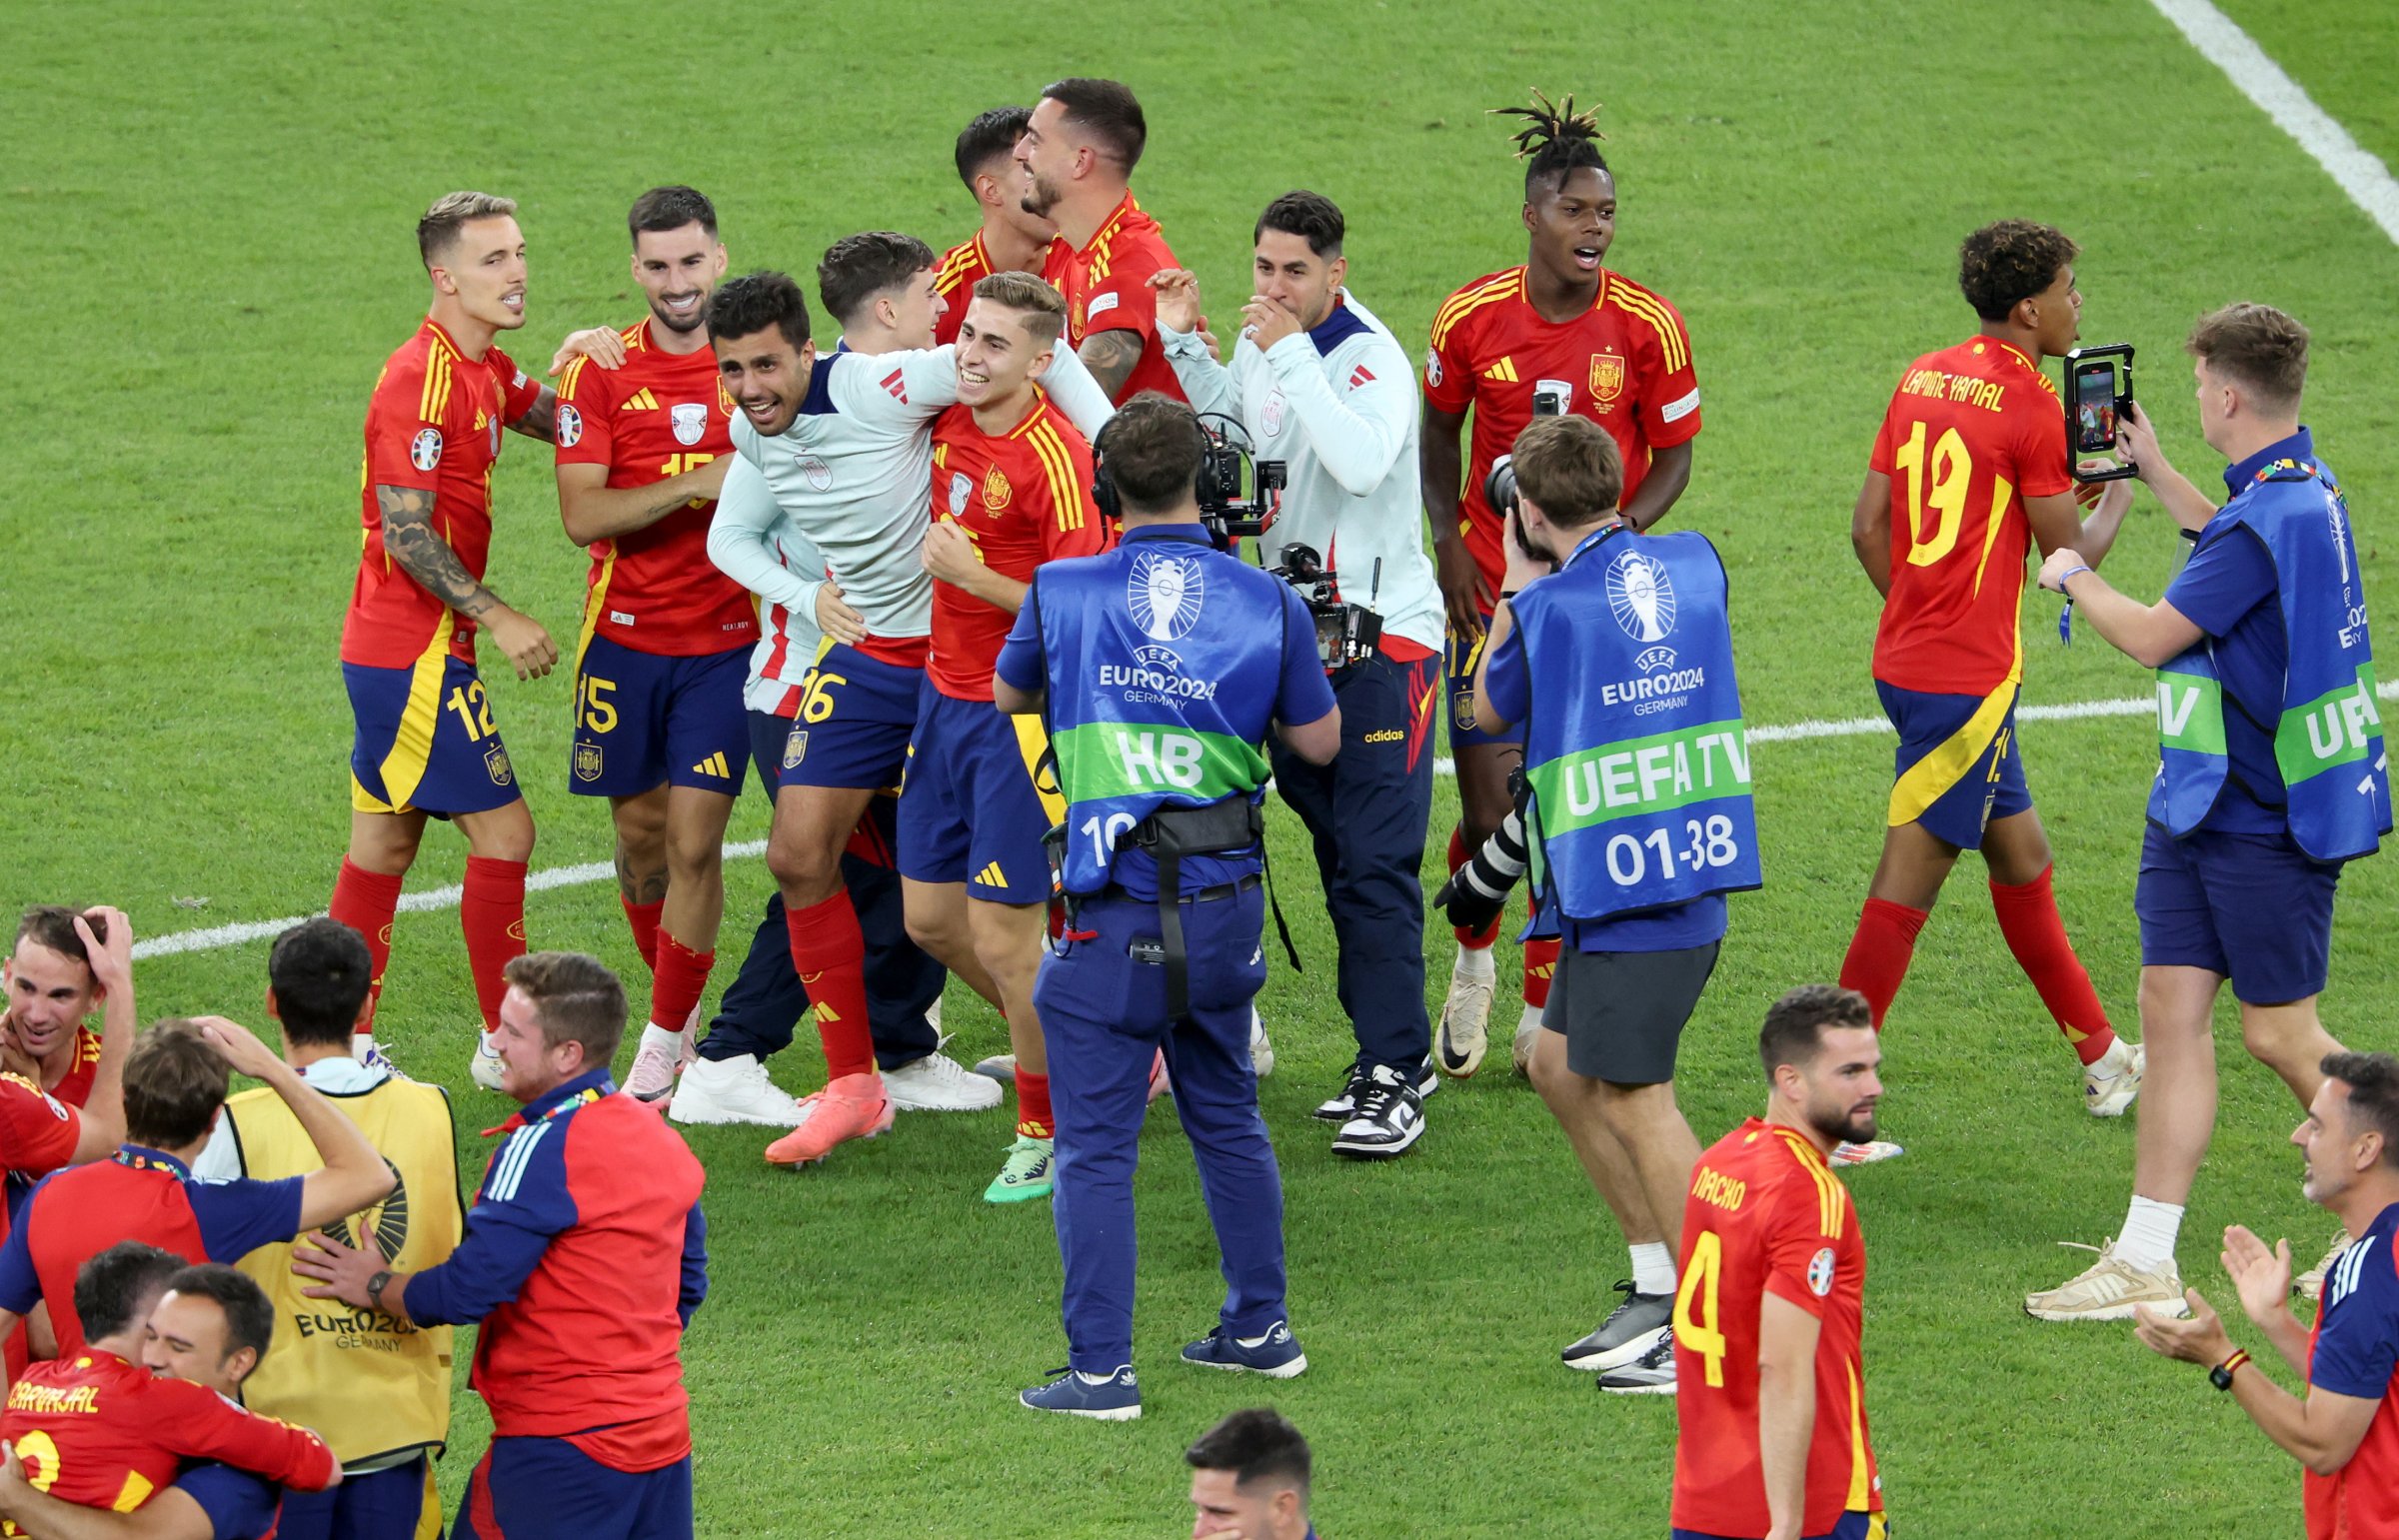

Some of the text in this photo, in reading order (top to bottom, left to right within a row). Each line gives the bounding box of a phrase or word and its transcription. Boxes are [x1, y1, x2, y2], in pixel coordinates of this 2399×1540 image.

[1901, 368, 2004, 413] LAMINE YAMAL
[1896, 421, 1972, 567] 19
[1136, 648, 1181, 671] UEFA
[1636, 650, 1675, 671] UEFA
[577, 673, 617, 734] 15
[794, 669, 847, 724] 16
[1100, 665, 1217, 701] EURO2024
[1124, 690, 1188, 711] GERMANY
[1601, 667, 1705, 706] EURO2024
[447, 680, 497, 743] 12
[1633, 696, 1688, 717] GERMANY
[1116, 732, 1203, 788] HB
[1364, 730, 1404, 744] adidas
[1565, 732, 1750, 816] UEFA TV
[1606, 814, 1737, 886] 01-38
[1691, 1165, 1746, 1212] NACHO
[1672, 1230, 1725, 1388] 4
[8, 1381, 100, 1413] CARVAJAL
